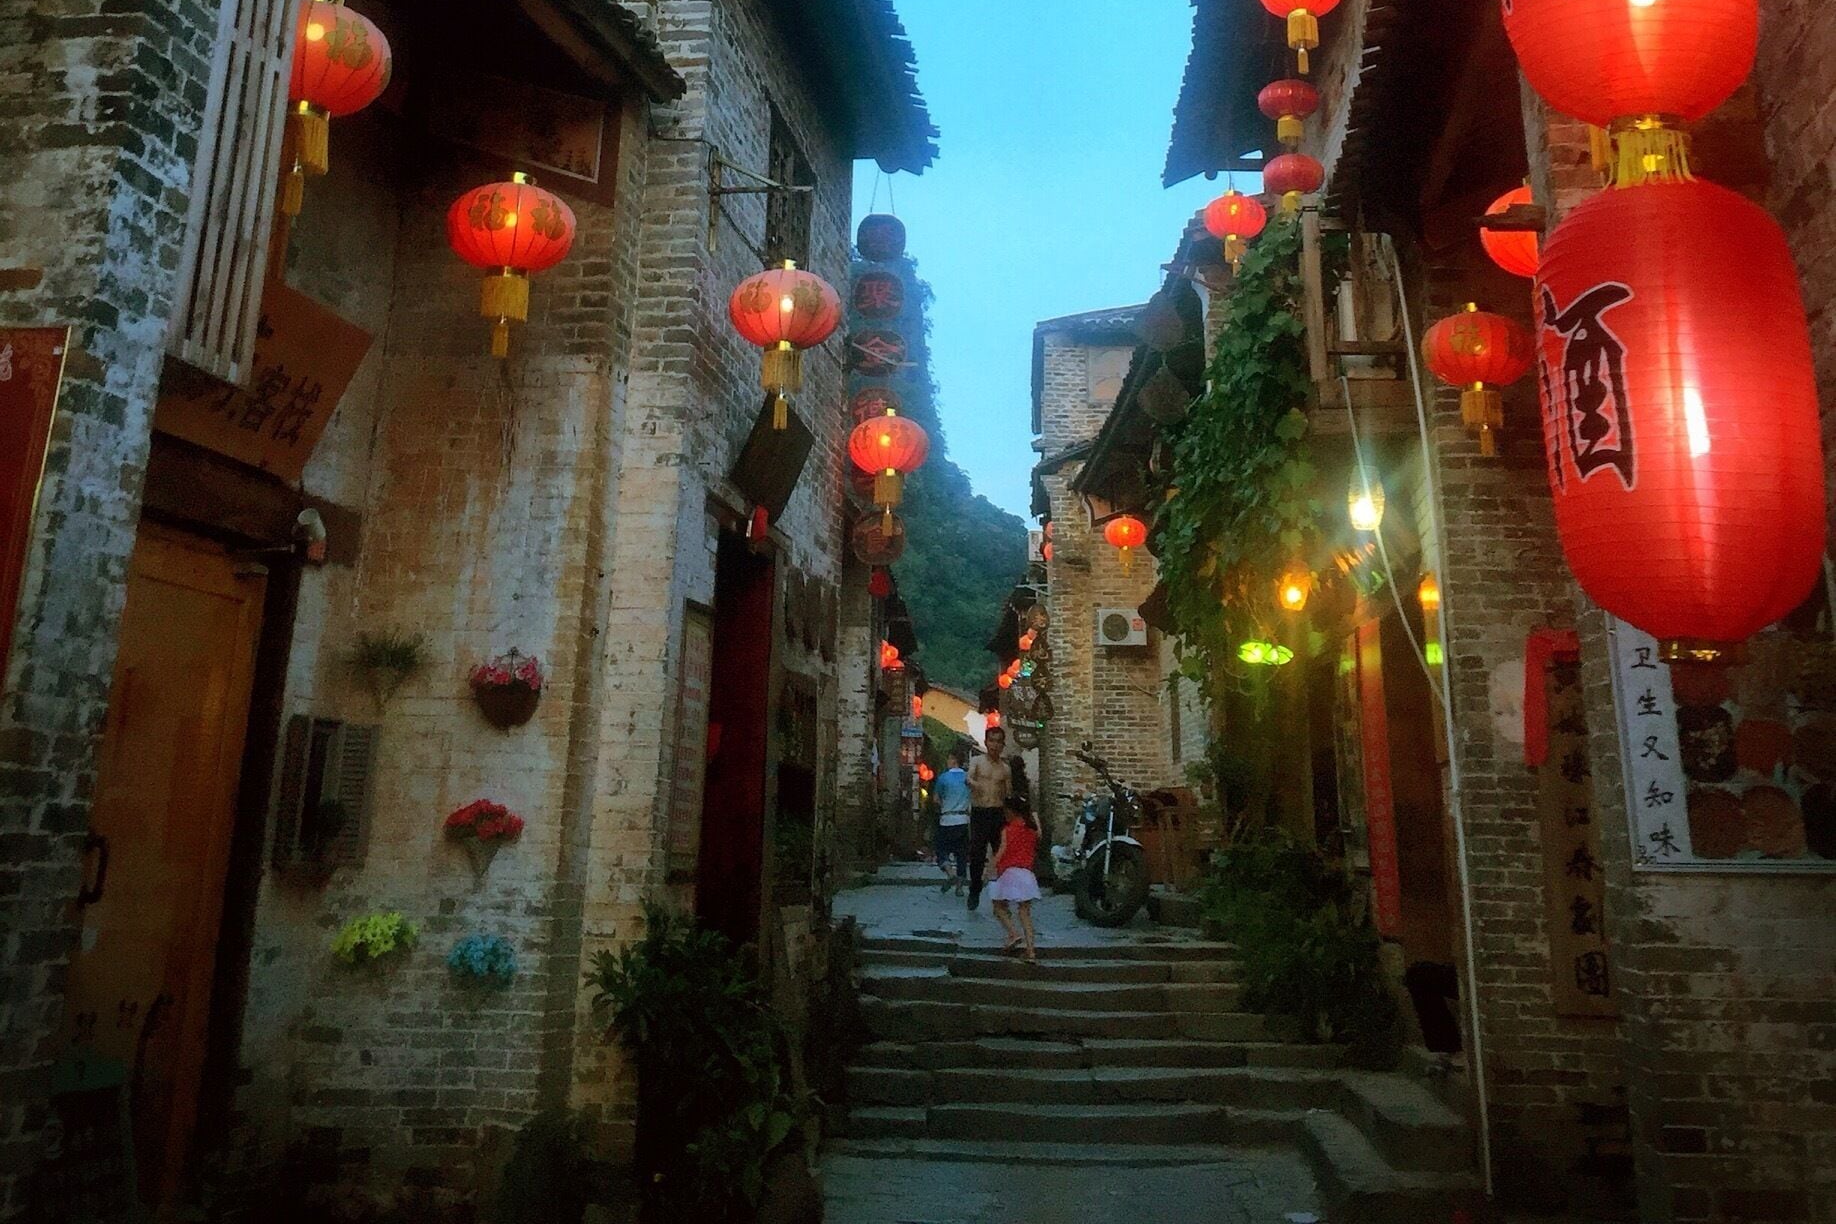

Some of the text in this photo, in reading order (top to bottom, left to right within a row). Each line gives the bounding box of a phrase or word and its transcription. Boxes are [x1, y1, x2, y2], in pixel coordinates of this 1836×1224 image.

[1536, 280, 1638, 497] 酒
[1630, 647, 1681, 856] 卫生又知味
